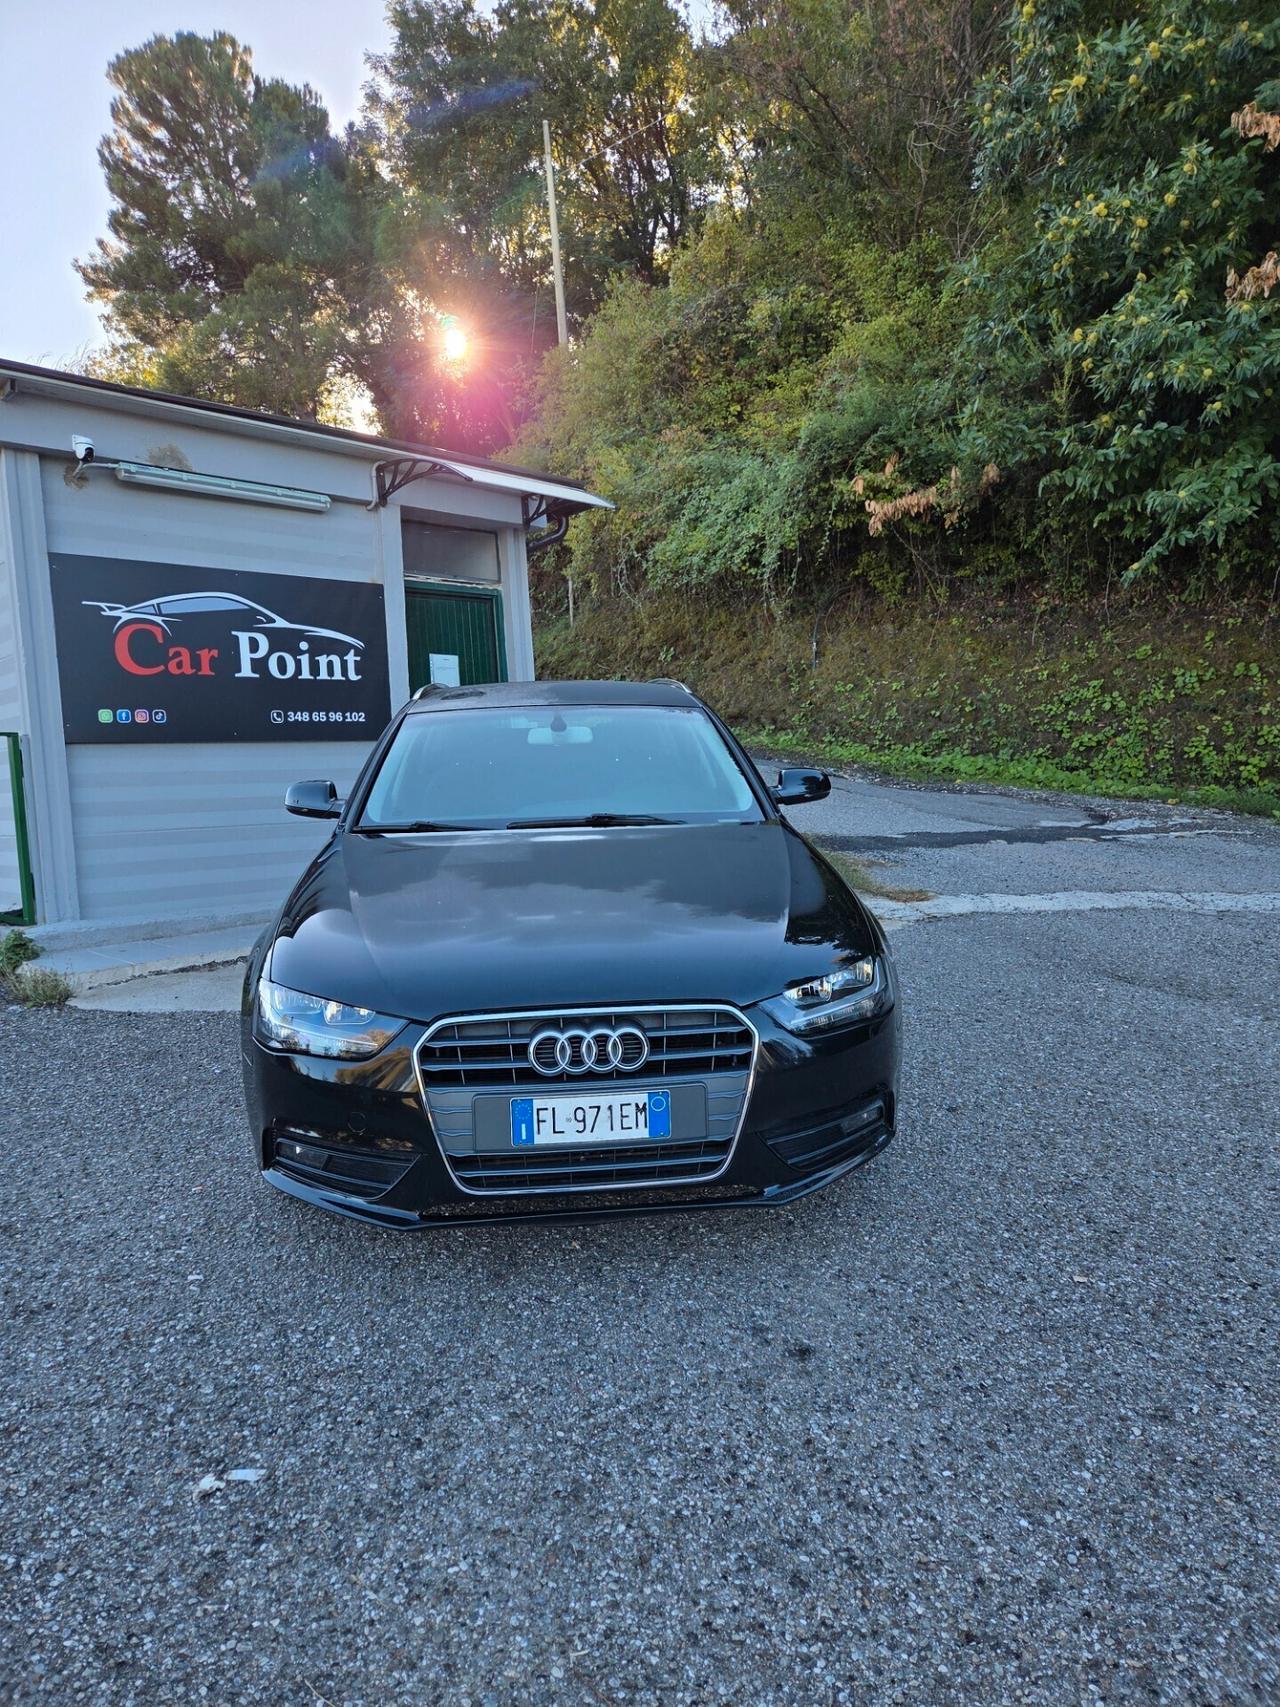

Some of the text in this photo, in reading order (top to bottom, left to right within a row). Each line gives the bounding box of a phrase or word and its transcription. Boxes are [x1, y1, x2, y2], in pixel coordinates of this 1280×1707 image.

[114, 623, 362, 681] Car Point
[287, 711, 366, 722] 348 65 96 102
